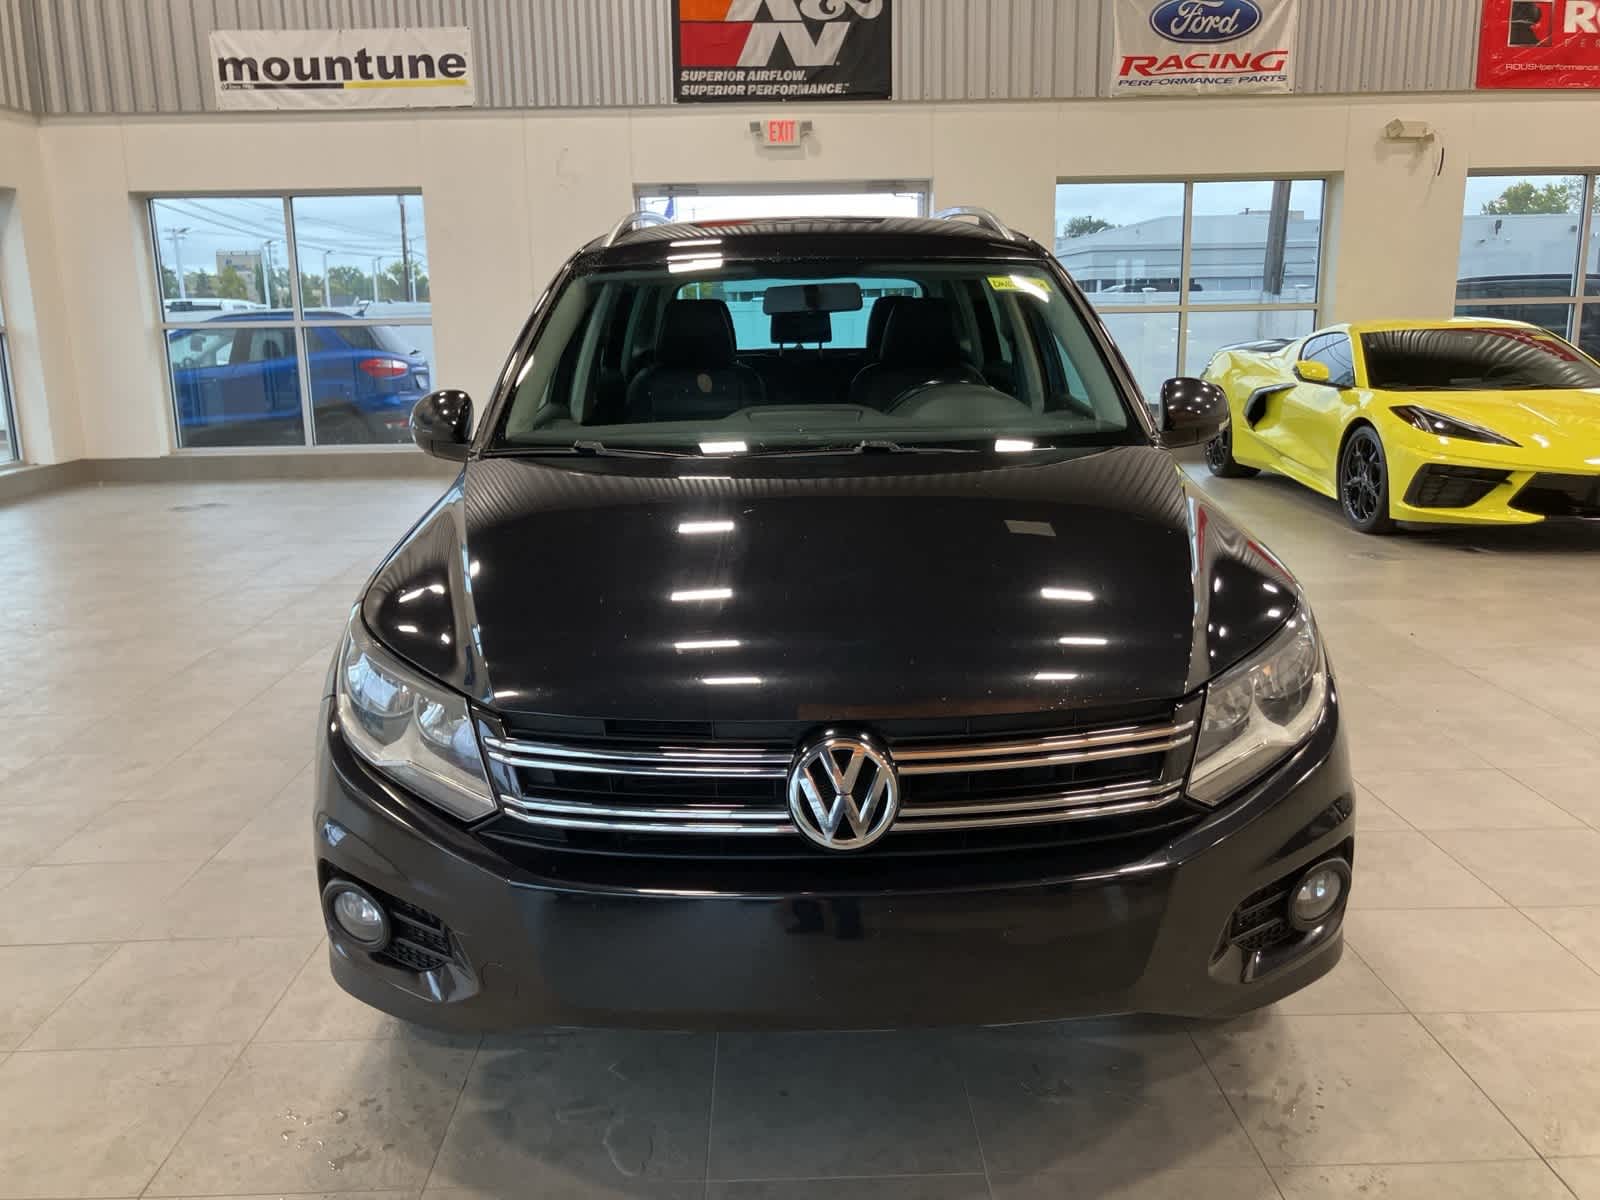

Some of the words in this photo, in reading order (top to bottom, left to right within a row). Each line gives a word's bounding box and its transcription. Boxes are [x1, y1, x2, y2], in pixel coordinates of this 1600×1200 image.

[1170, 0, 1241, 35] Ford
[1563, 0, 1600, 33] R
[217, 47, 467, 82] mountune
[680, 70, 746, 82] SUPERIOR
[747, 69, 807, 81] AIRFLOW.
[1119, 51, 1289, 77] RACING
[680, 84, 746, 96] SUPERIOR
[1118, 76, 1234, 87] PERFORMANCE
[1238, 74, 1288, 83] PARTS
[768, 121, 796, 143] EXIT
